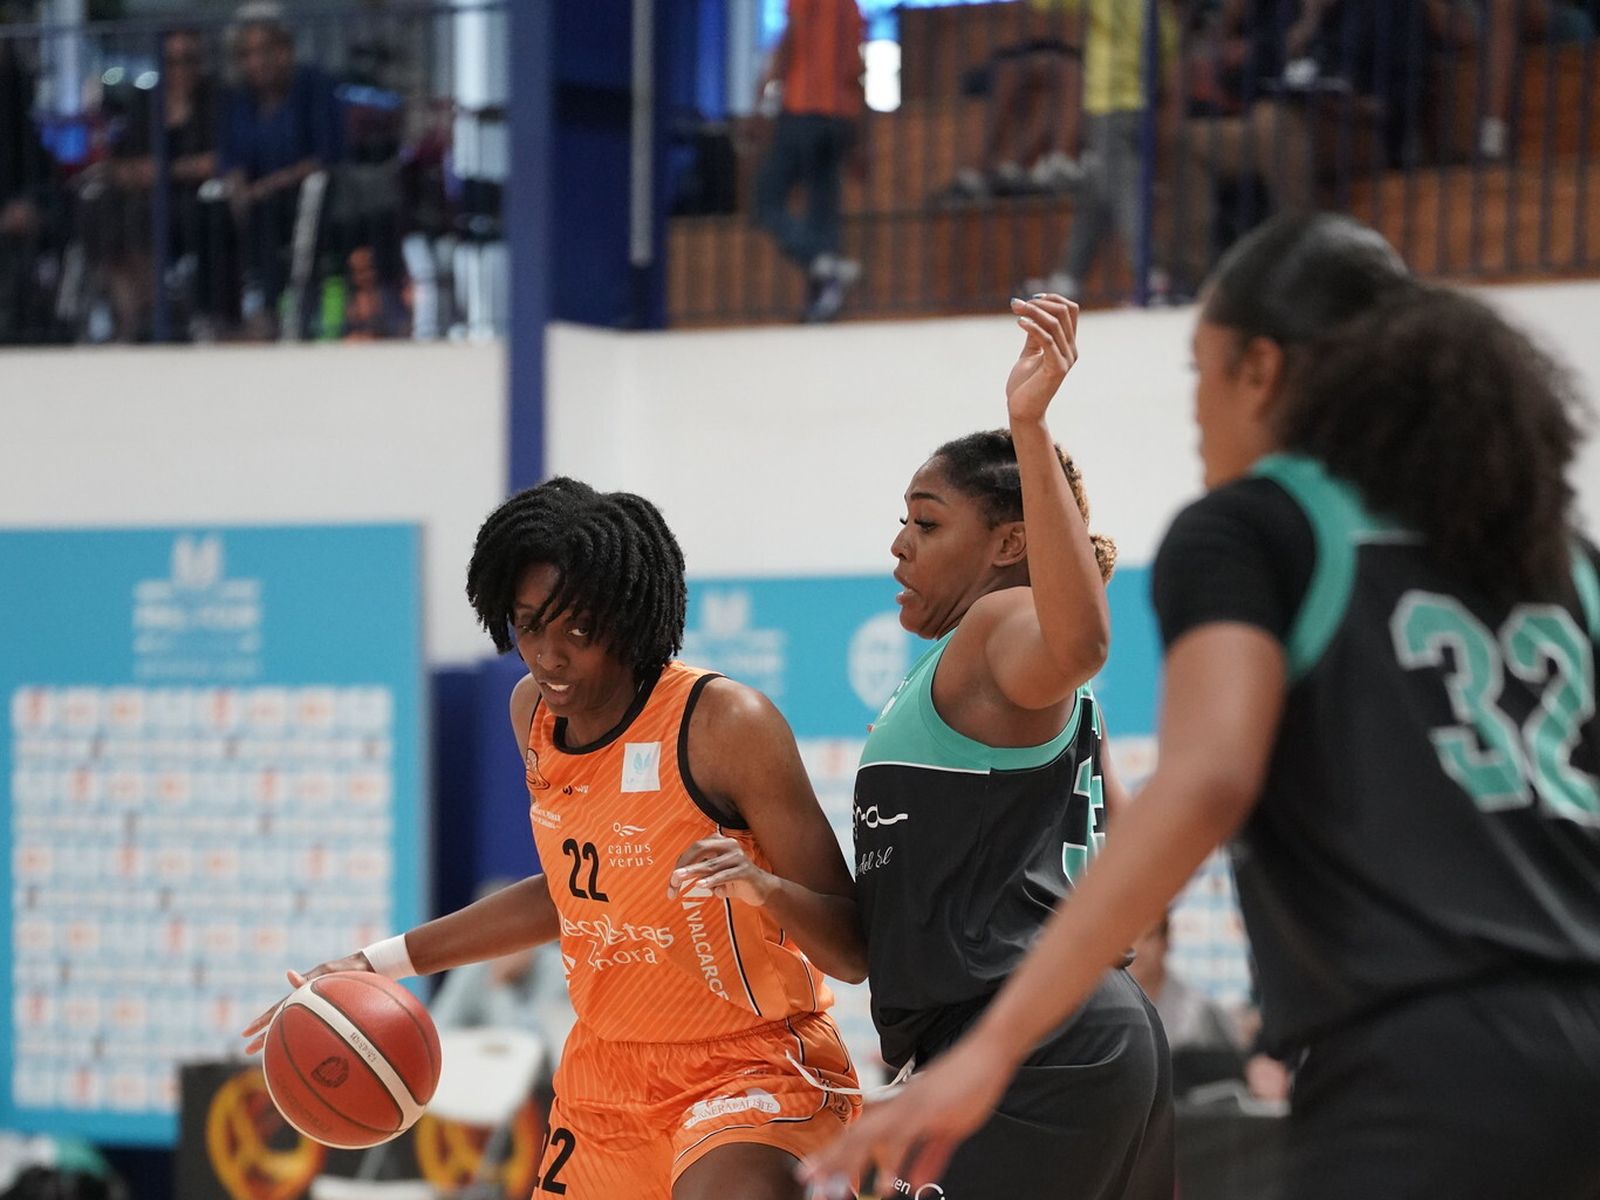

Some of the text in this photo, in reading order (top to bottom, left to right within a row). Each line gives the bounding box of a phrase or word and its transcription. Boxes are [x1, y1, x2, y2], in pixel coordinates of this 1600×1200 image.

[1389, 588, 1600, 828] 32
[562, 838, 609, 903] 22
[608, 842, 652, 855] cañus
[609, 856, 654, 868] verus
[537, 1123, 576, 1195] 2
